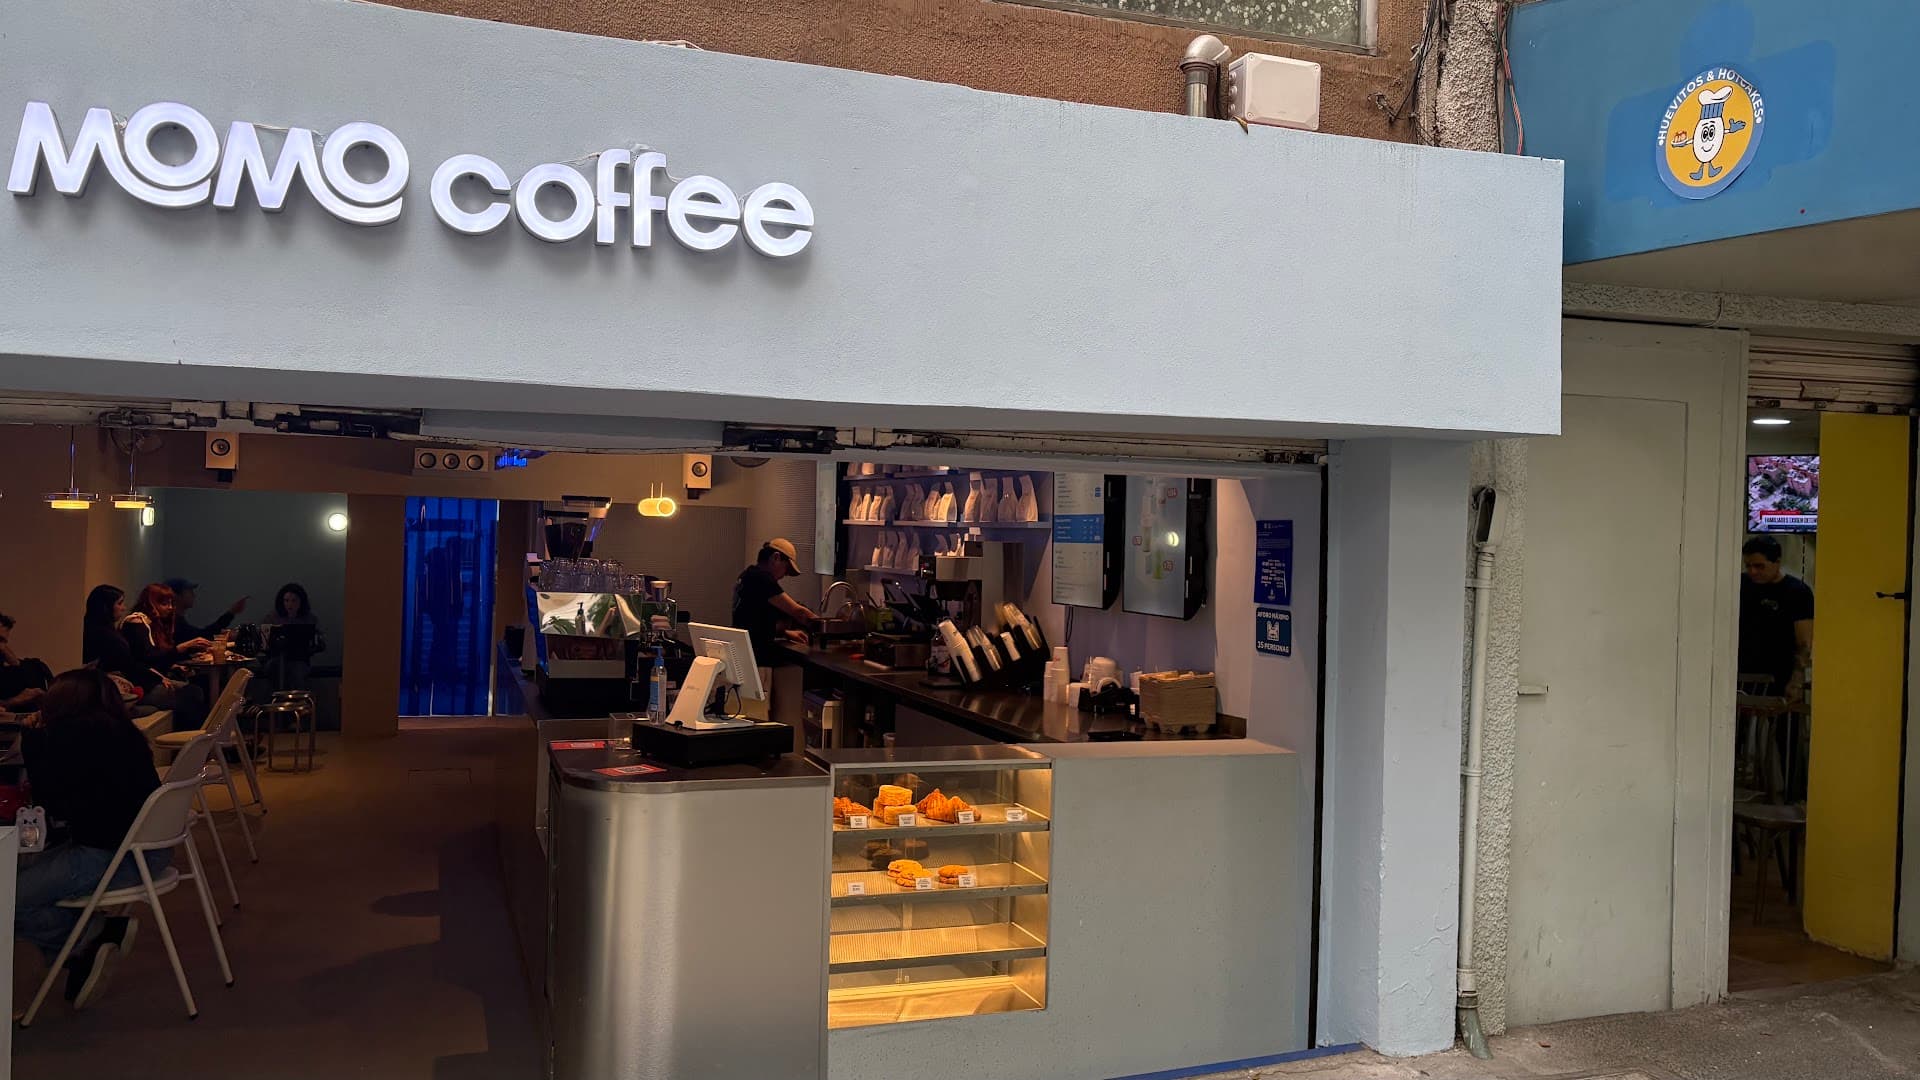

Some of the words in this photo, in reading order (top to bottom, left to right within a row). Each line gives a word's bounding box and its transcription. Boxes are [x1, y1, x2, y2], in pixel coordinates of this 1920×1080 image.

[1657, 75, 1704, 141] HUEVITOS
[1706, 70, 1715, 82] &
[6, 101, 410, 226] MOMO
[430, 148, 815, 258] coffee
[1264, 642, 1290, 653] PERSONAS
